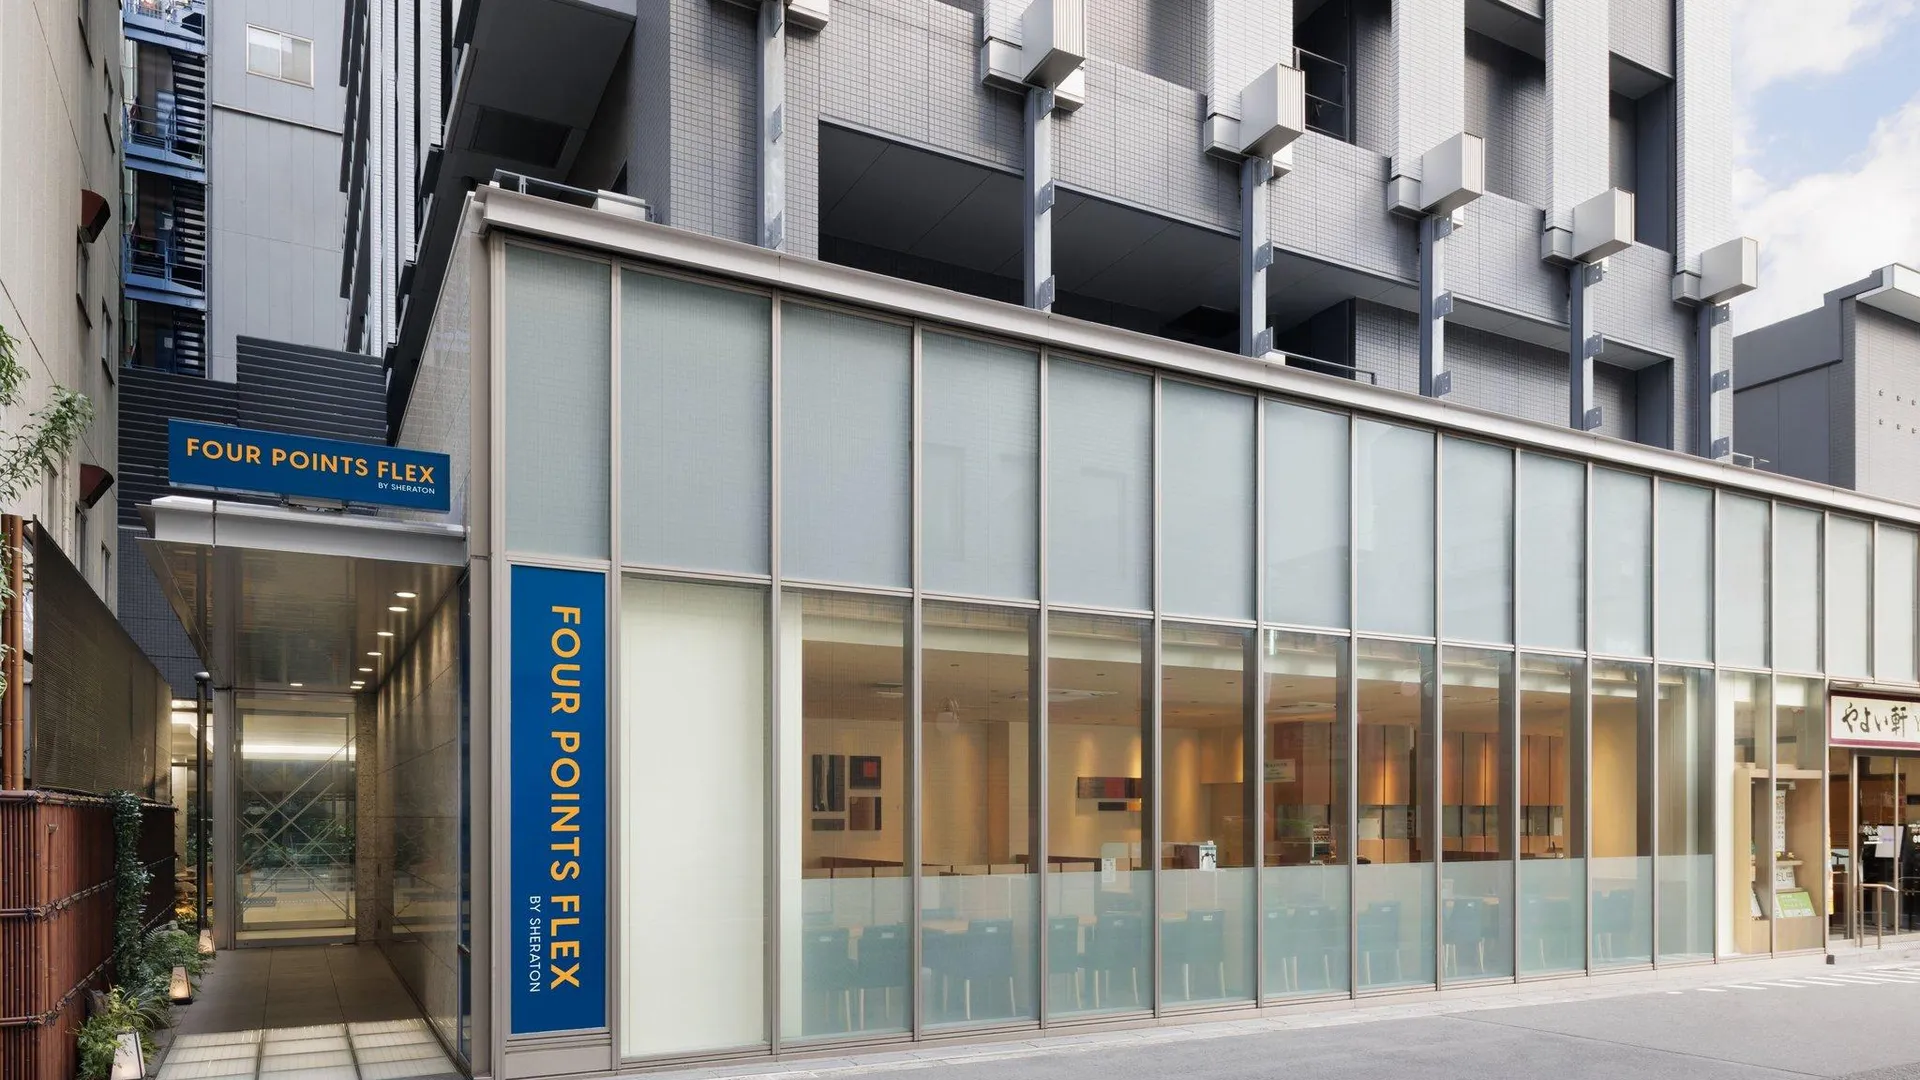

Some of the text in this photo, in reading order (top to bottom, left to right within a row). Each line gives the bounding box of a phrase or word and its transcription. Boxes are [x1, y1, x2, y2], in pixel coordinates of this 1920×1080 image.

[186, 438, 435, 484] FOUR POINTS FLEX
[378, 482, 436, 495] BY SHERATON
[1842, 702, 1908, 738] やよい軒
[550, 605, 581, 990] FOUR POINTS FLEX
[529, 896, 541, 993] BY SHERATON
